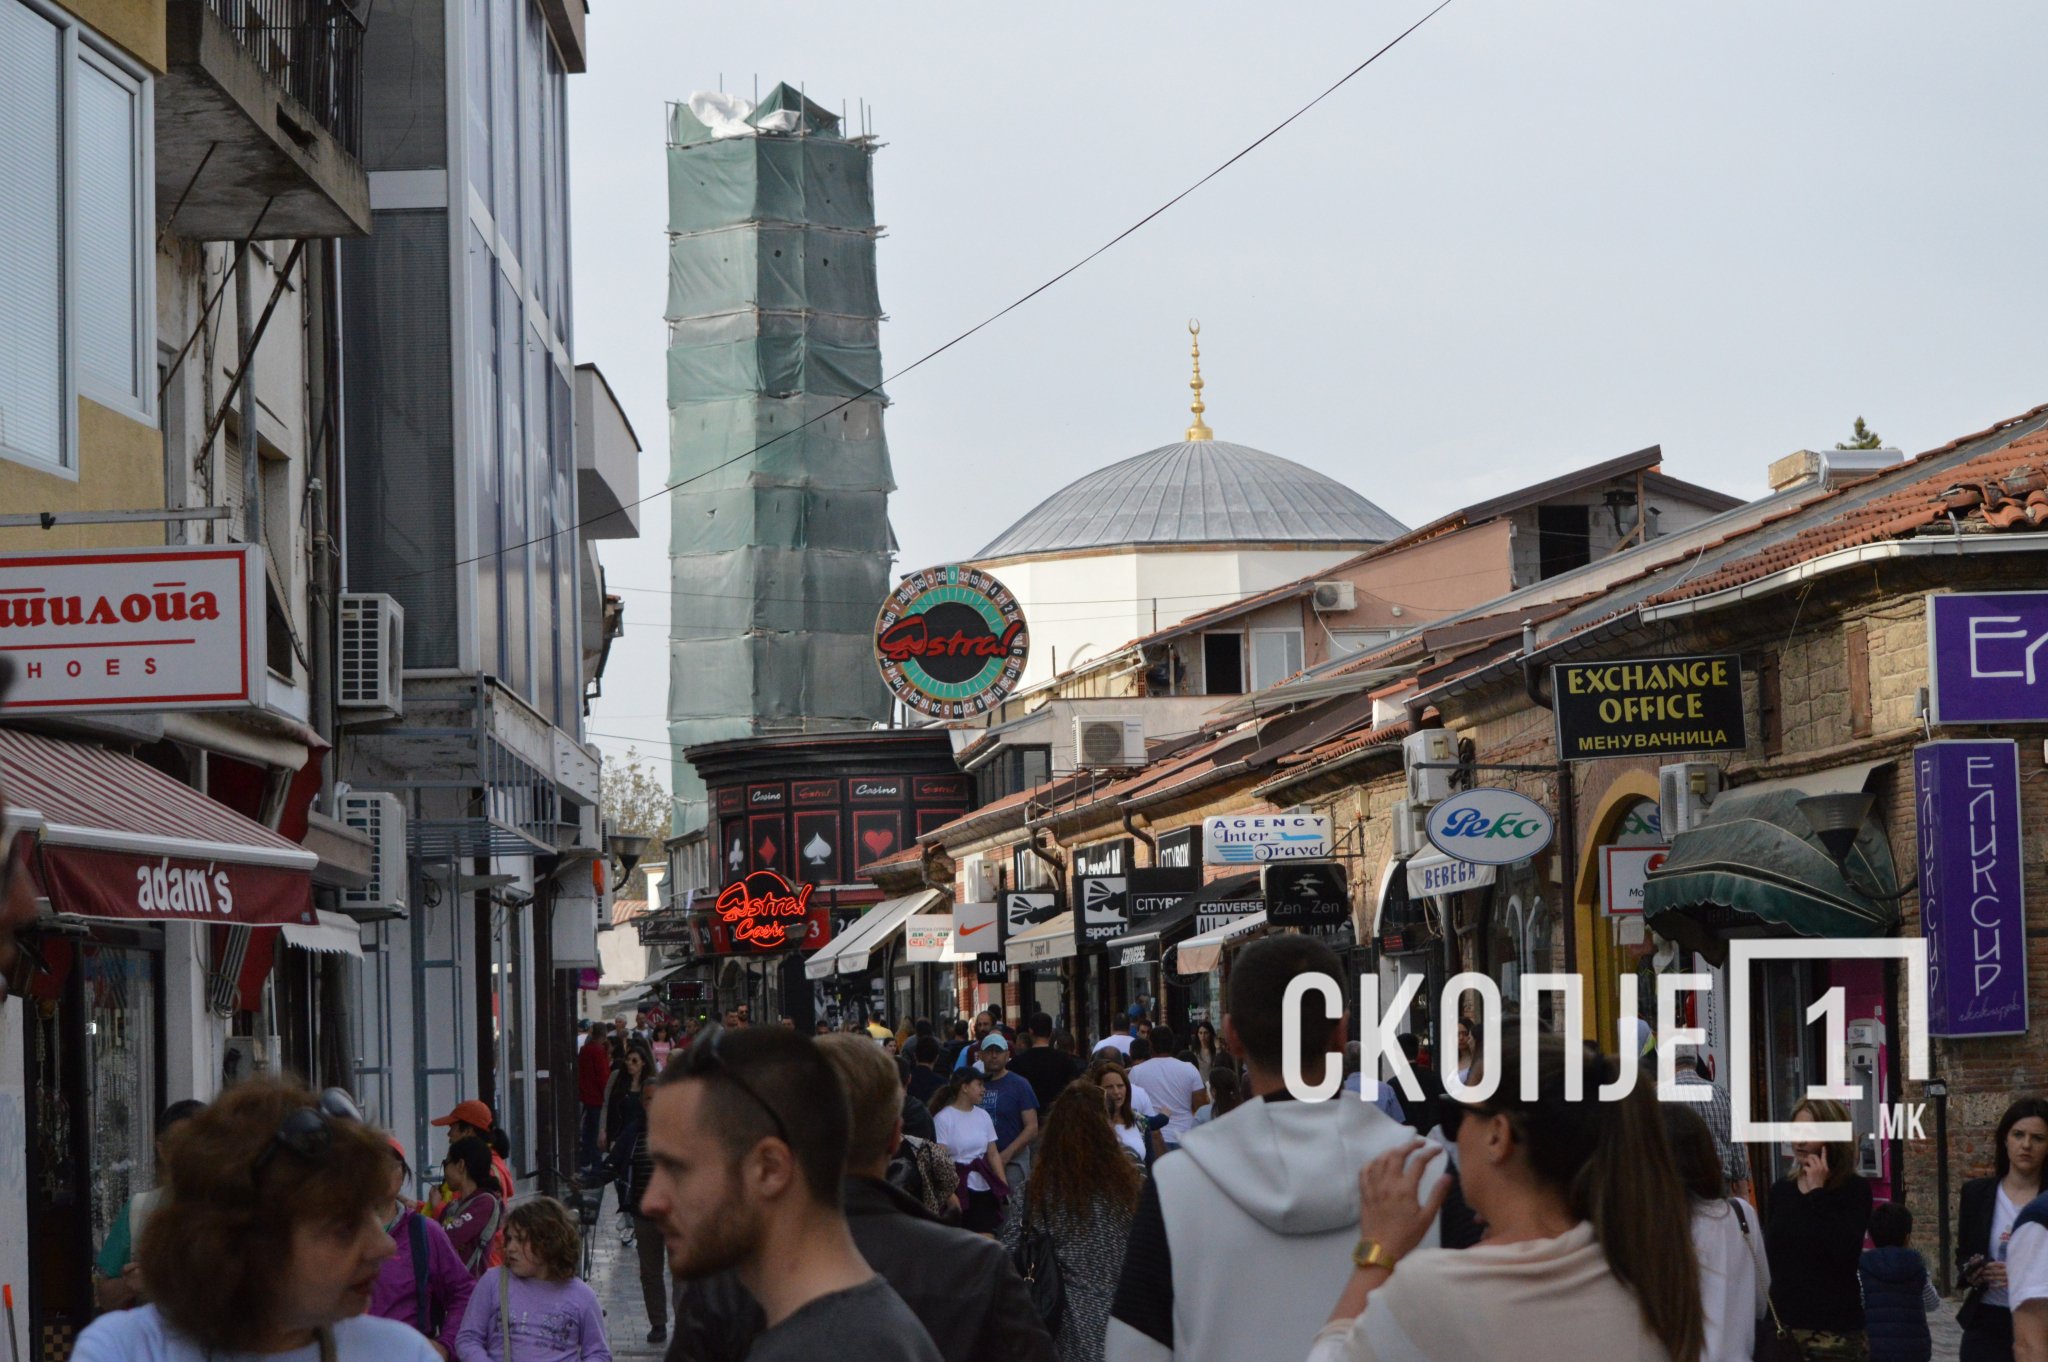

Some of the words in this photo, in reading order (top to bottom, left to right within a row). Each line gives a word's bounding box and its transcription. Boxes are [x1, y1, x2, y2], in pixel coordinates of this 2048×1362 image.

[927, 575, 934, 584] 3
[936, 571, 946, 581] 26
[950, 571, 956, 580] 0
[959, 572, 969, 582] 32
[970, 574, 980, 585] 15
[915, 579, 926, 590] 35
[980, 578, 990, 590] 19
[905, 585, 916, 596] 12
[990, 586, 997, 595] 4
[897, 593, 909, 604] 28
[996, 593, 1008, 604] 21
[891, 603, 900, 611] 7
[886, 612, 896, 623] 29
[27, 657, 158, 678] HOES
[1011, 658, 1021, 669] 27
[887, 668, 898, 678] 14
[1006, 669, 1017, 678] 13
[1567, 660, 1729, 694] EXCHANGE
[893, 676, 905, 688] 20
[1000, 677, 1012, 688] 36
[993, 685, 1004, 696] 11
[910, 692, 922, 704] 33
[977, 698, 984, 708] 8
[982, 693, 994, 705] 30
[920, 699, 930, 711] 16
[931, 702, 941, 713] 24
[944, 705, 950, 714] 5
[953, 704, 963, 714] 10
[964, 702, 975, 713] 23
[1599, 693, 1704, 723] OFFICE
[1578, 730, 1728, 751] МЕНУВАЧНИЦА
[752, 790, 782, 801] Casino
[855, 784, 897, 796] Casino
[1214, 818, 1325, 829] AGENCY
[1214, 829, 1269, 843] Inter
[1161, 842, 1189, 868] CITYBOX
[1255, 842, 1326, 861] Travel
[1424, 863, 1477, 890] BEBEGA
[137, 857, 233, 914] adam's
[1629, 888, 1645, 897] Mo
[1136, 897, 1184, 911] CITYB
[1199, 902, 1264, 913] CONVERSE
[1273, 901, 1302, 915] Zen
[1312, 900, 1340, 914] Zen
[735, 918, 785, 940] Casi
[809, 919, 820, 938] 3
[1086, 924, 1122, 940] sport
[979, 960, 1006, 974] ICON
